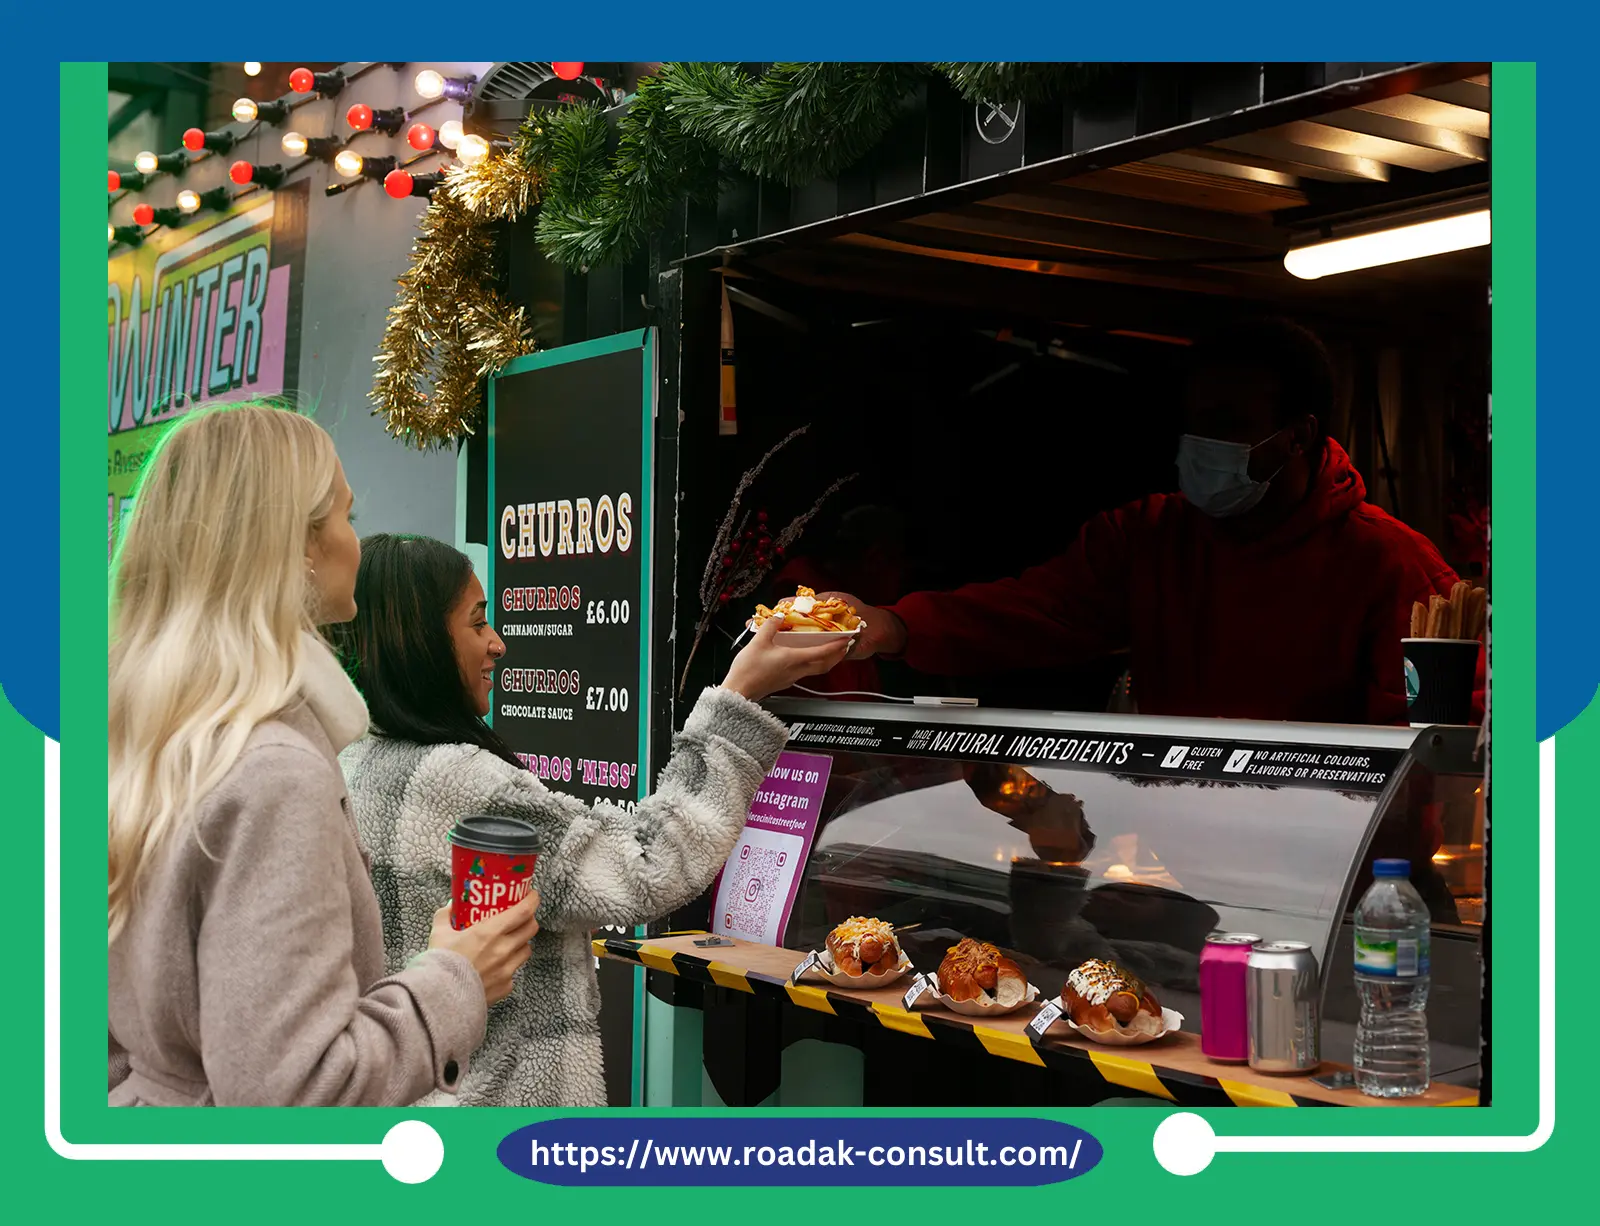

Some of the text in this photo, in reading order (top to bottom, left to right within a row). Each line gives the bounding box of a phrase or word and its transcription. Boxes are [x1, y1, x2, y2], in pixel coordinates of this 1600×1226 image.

[108, 245, 269, 433] WINTER
[500, 492, 632, 559] CHURROS
[502, 585, 581, 611] CHURROS
[586, 600, 630, 624] £6.00
[502, 624, 573, 636] CINNAMON/SUGAR
[501, 668, 580, 695] CHURROS
[586, 686, 629, 712] £7.00
[501, 704, 573, 720] CHOCOLATE SAUCE
[804, 723, 815, 731] NO
[813, 723, 846, 733] ARTIFICIAL
[911, 729, 935, 740] MADE
[797, 733, 882, 747] FLAVOURS OR PRESERVATIVES
[906, 739, 929, 750] WITH
[928, 730, 1135, 765] NATURAL INGREDIENTS
[1190, 746, 1223, 758] GLUTEN
[1254, 750, 1371, 768] NO ARTIFICIAL COLOURS,
[1182, 760, 1205, 771] FREE
[1246, 764, 1386, 784] FLAVOURS OR PRESERVATIVES
[791, 769, 804, 782] us
[804, 770, 819, 784] on
[752, 790, 809, 810] nstagram
